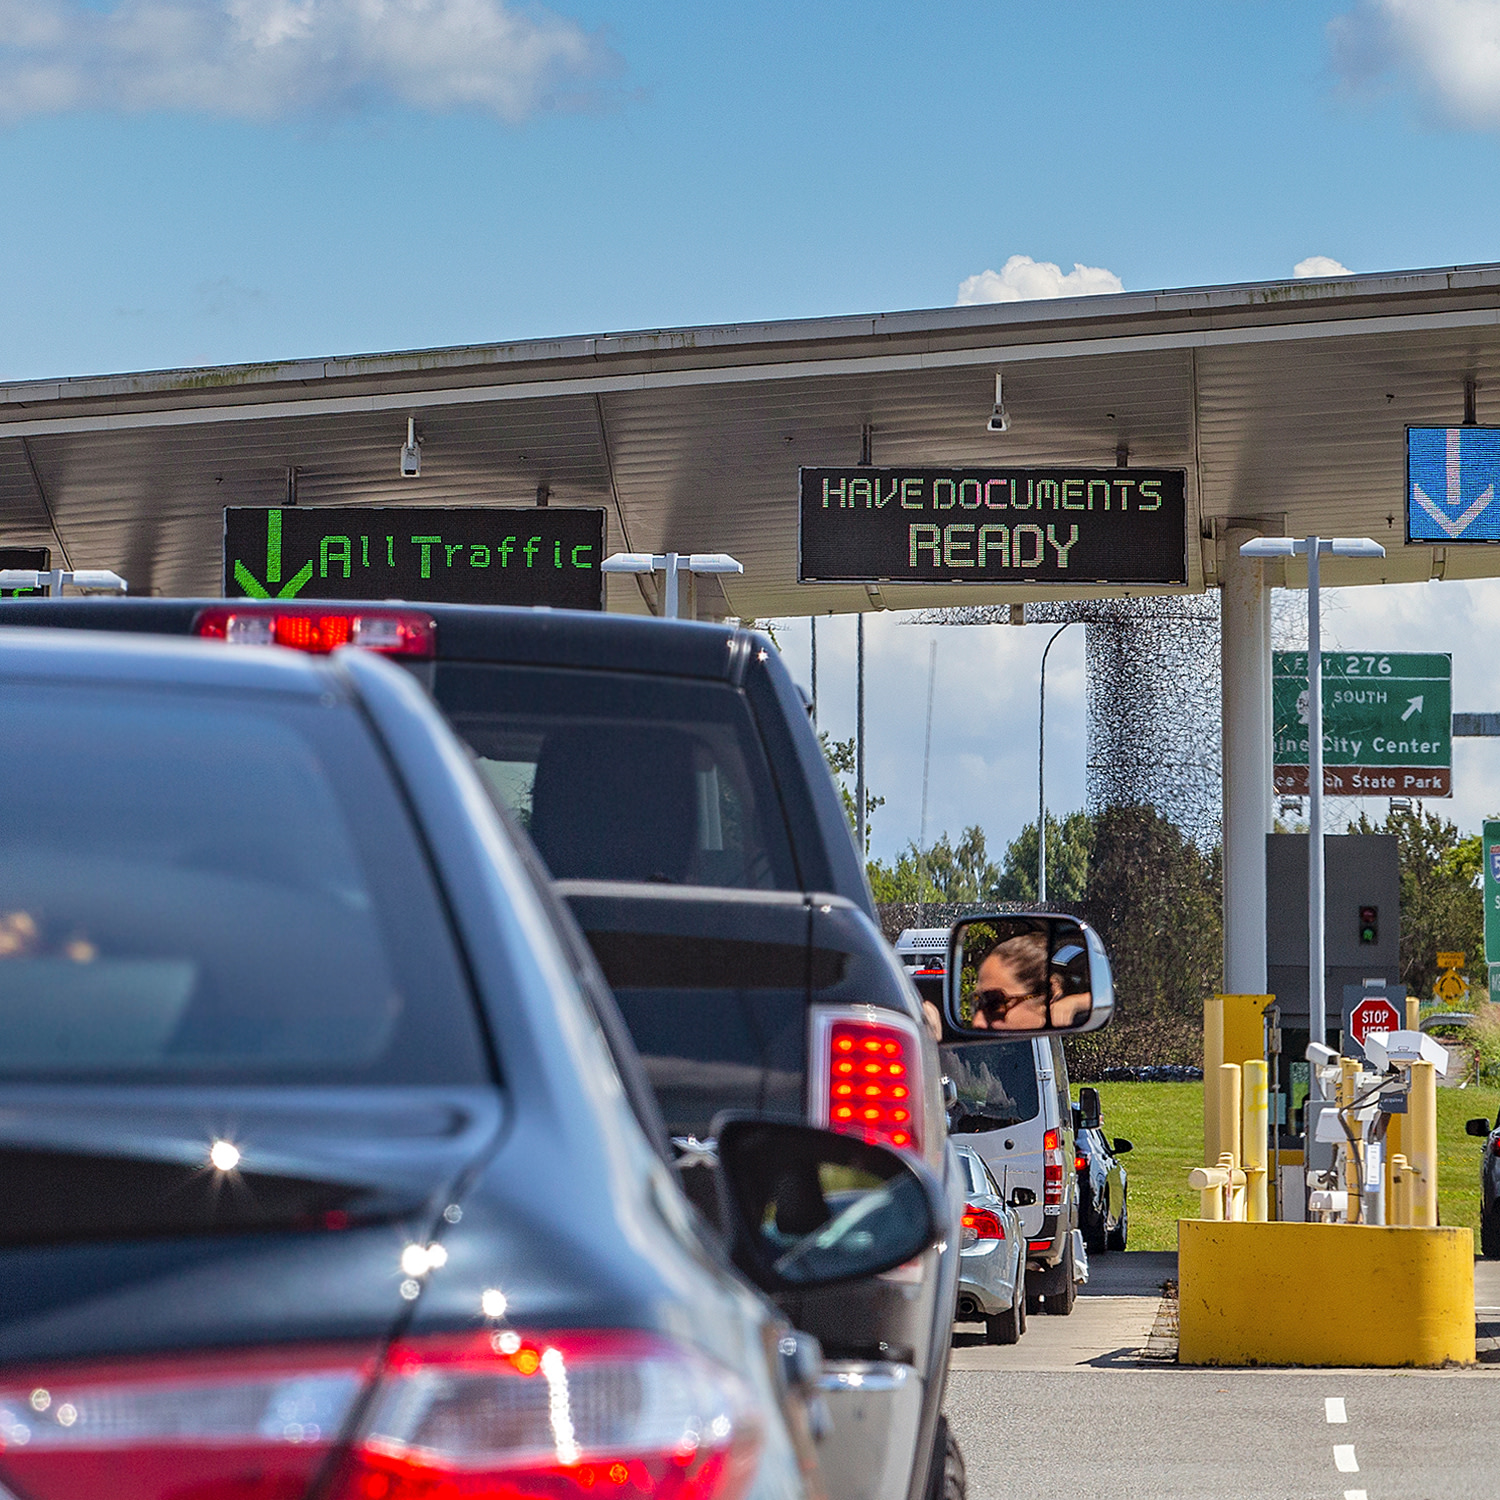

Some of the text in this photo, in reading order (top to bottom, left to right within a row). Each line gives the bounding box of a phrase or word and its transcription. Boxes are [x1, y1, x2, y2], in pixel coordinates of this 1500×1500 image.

[822, 478, 1162, 511] HAVE DOCUMENTS
[908, 523, 1080, 569] READY
[320, 535, 593, 580] All Traffic
[1294, 656, 1392, 674] ET 276
[1334, 691, 1388, 704] SOUTH
[1322, 737, 1362, 757] City
[1373, 737, 1441, 753] Center
[1352, 775, 1396, 788] State
[1404, 775, 1442, 789] Park
[1362, 1009, 1389, 1024] STOP
